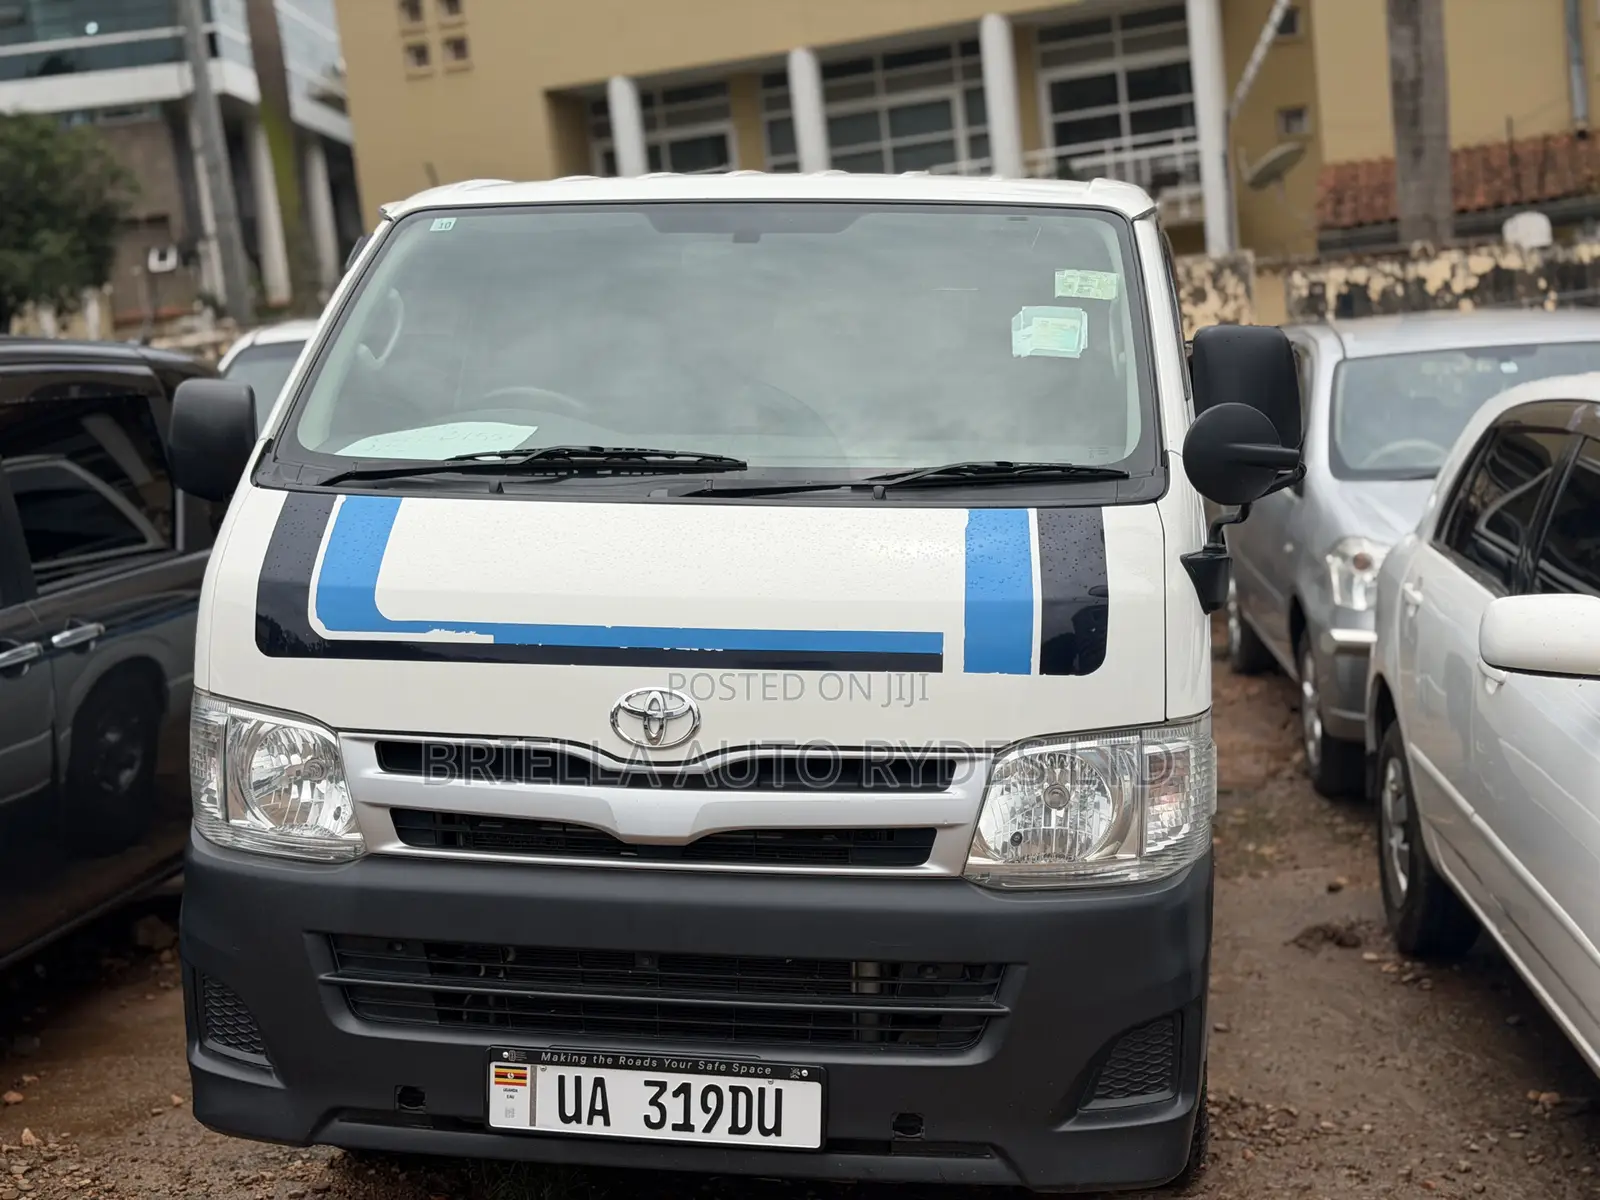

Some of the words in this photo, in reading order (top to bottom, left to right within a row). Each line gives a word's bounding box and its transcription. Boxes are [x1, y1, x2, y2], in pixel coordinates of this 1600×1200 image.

[540, 1051, 588, 1065] Making
[593, 1055, 613, 1065] the
[618, 1056, 658, 1067] Roads
[663, 1058, 693, 1069] Your
[697, 1060, 727, 1072] Safe
[732, 1063, 772, 1075] Space
[557, 1074, 611, 1127] UA
[643, 1079, 783, 1138] 319DU
